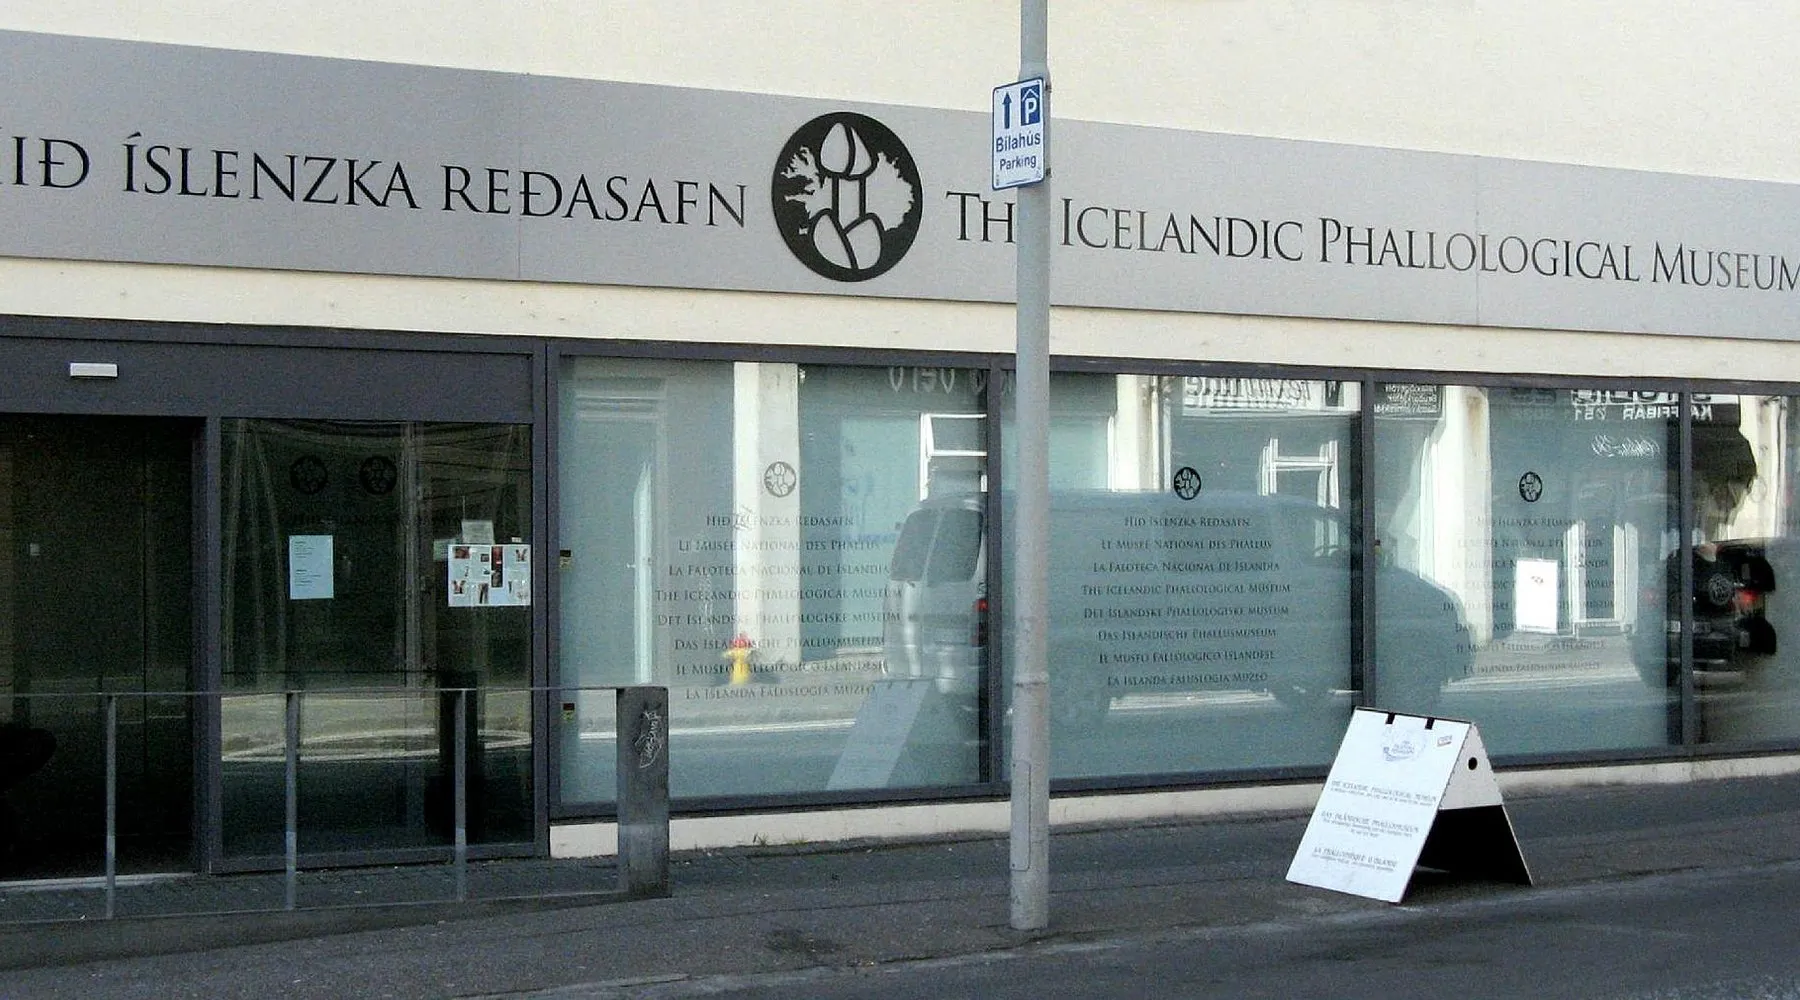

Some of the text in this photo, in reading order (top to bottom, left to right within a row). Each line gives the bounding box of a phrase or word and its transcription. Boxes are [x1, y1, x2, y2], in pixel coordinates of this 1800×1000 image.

[0, 126, 747, 229] IÐ ÍSLENZKA REÐASAFN
[1000, 155, 1037, 170] Parking
[946, 191, 1017, 243] TH
[1060, 198, 1304, 262] ICELANDIC
[1318, 217, 1640, 282] PHALLOLOGICAL
